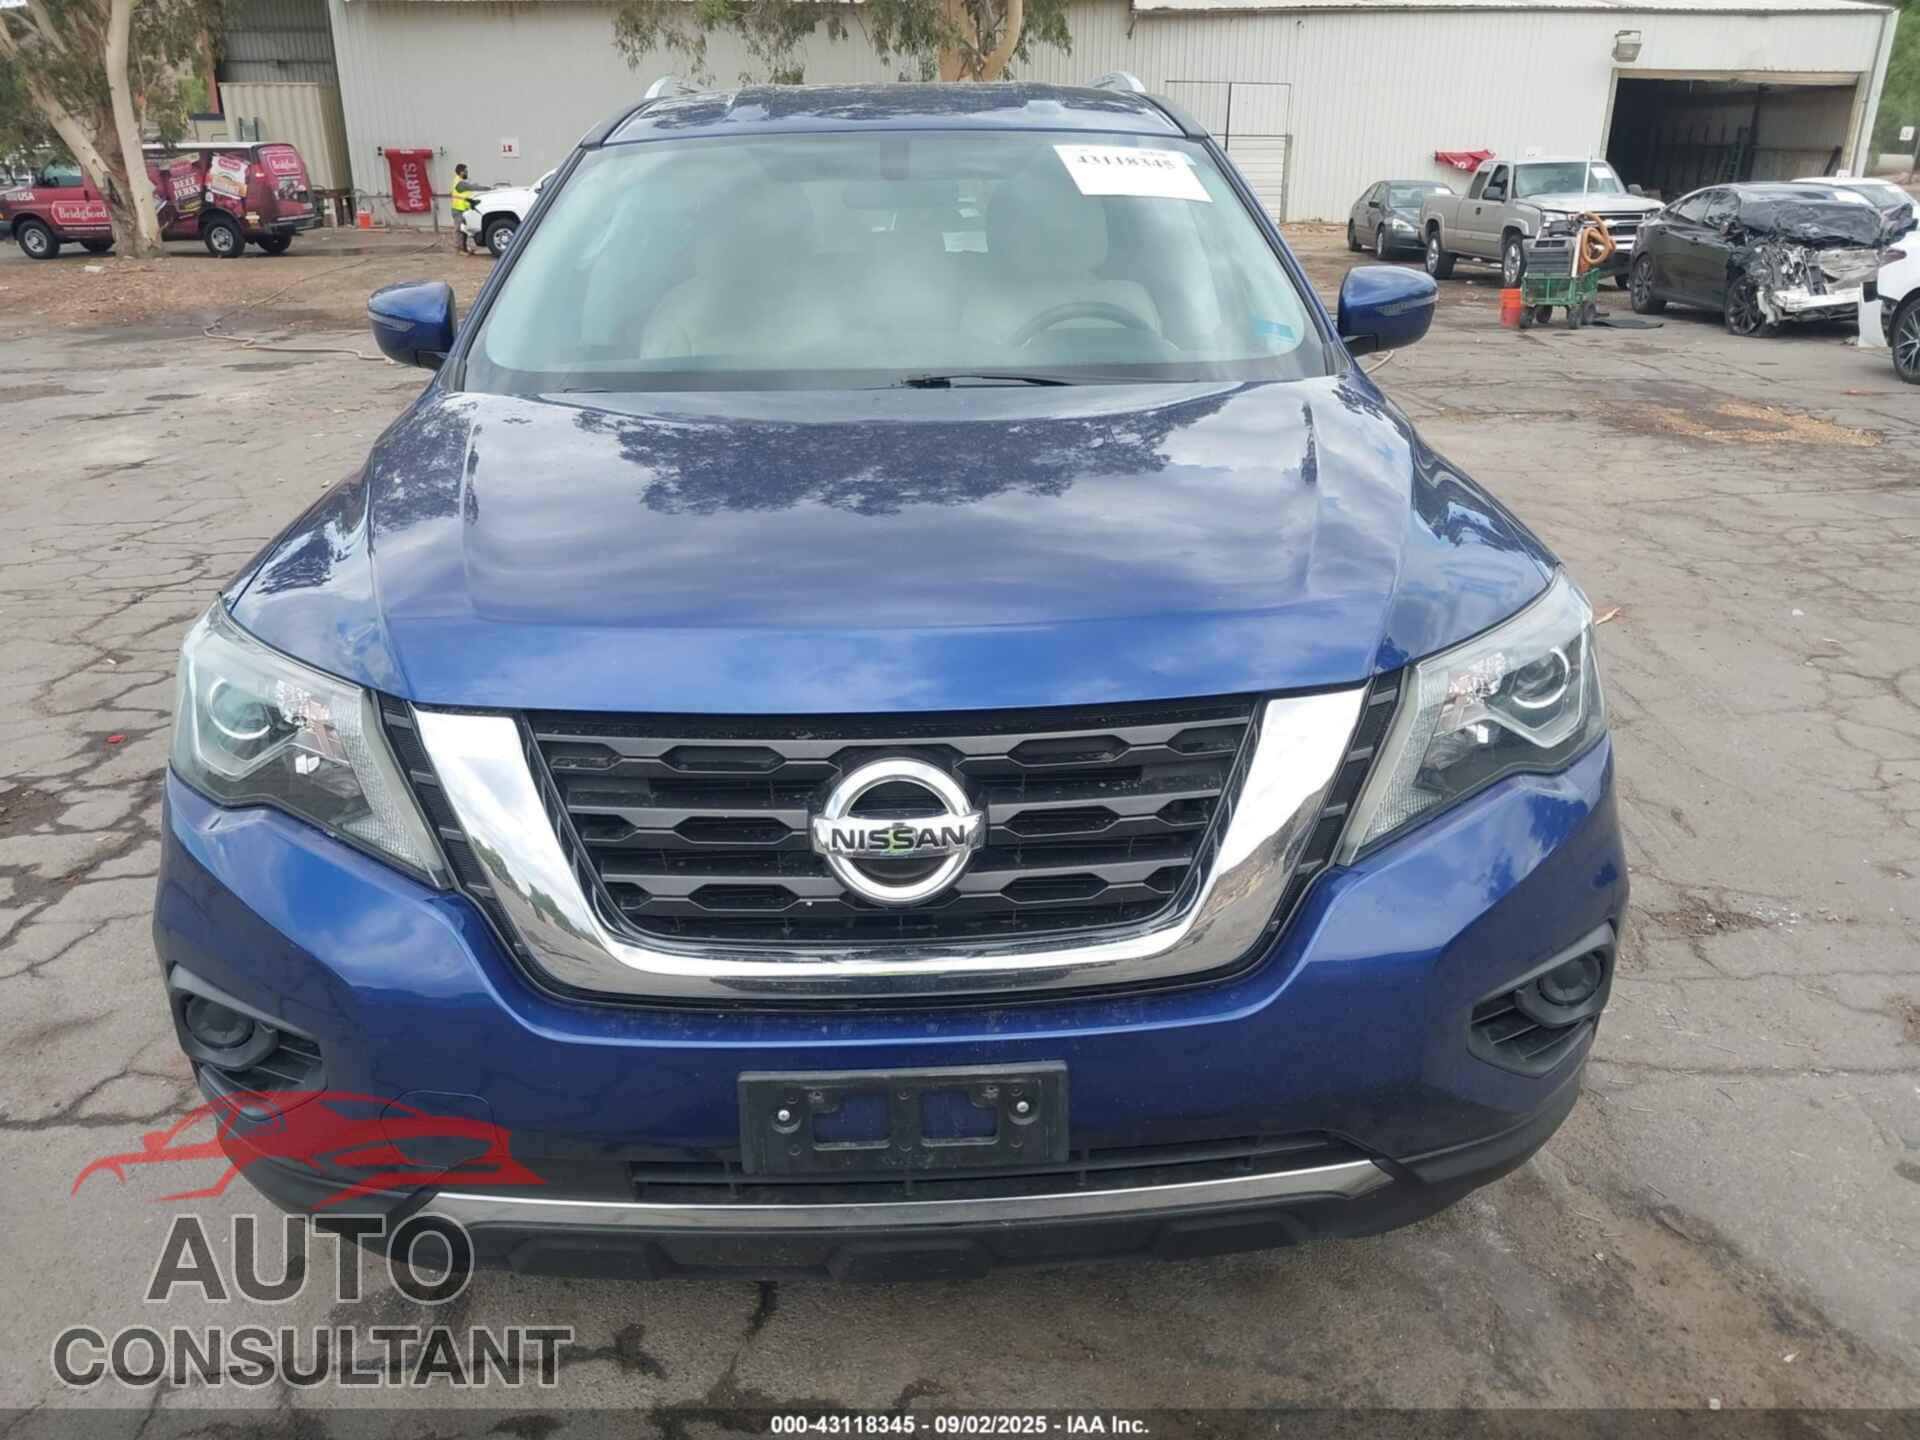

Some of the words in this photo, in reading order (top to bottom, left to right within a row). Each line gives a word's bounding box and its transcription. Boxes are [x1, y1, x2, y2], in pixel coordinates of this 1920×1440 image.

[17, 191, 36, 201] USA
[402, 162, 425, 208] PARTS
[831, 825, 966, 850] NISSAN
